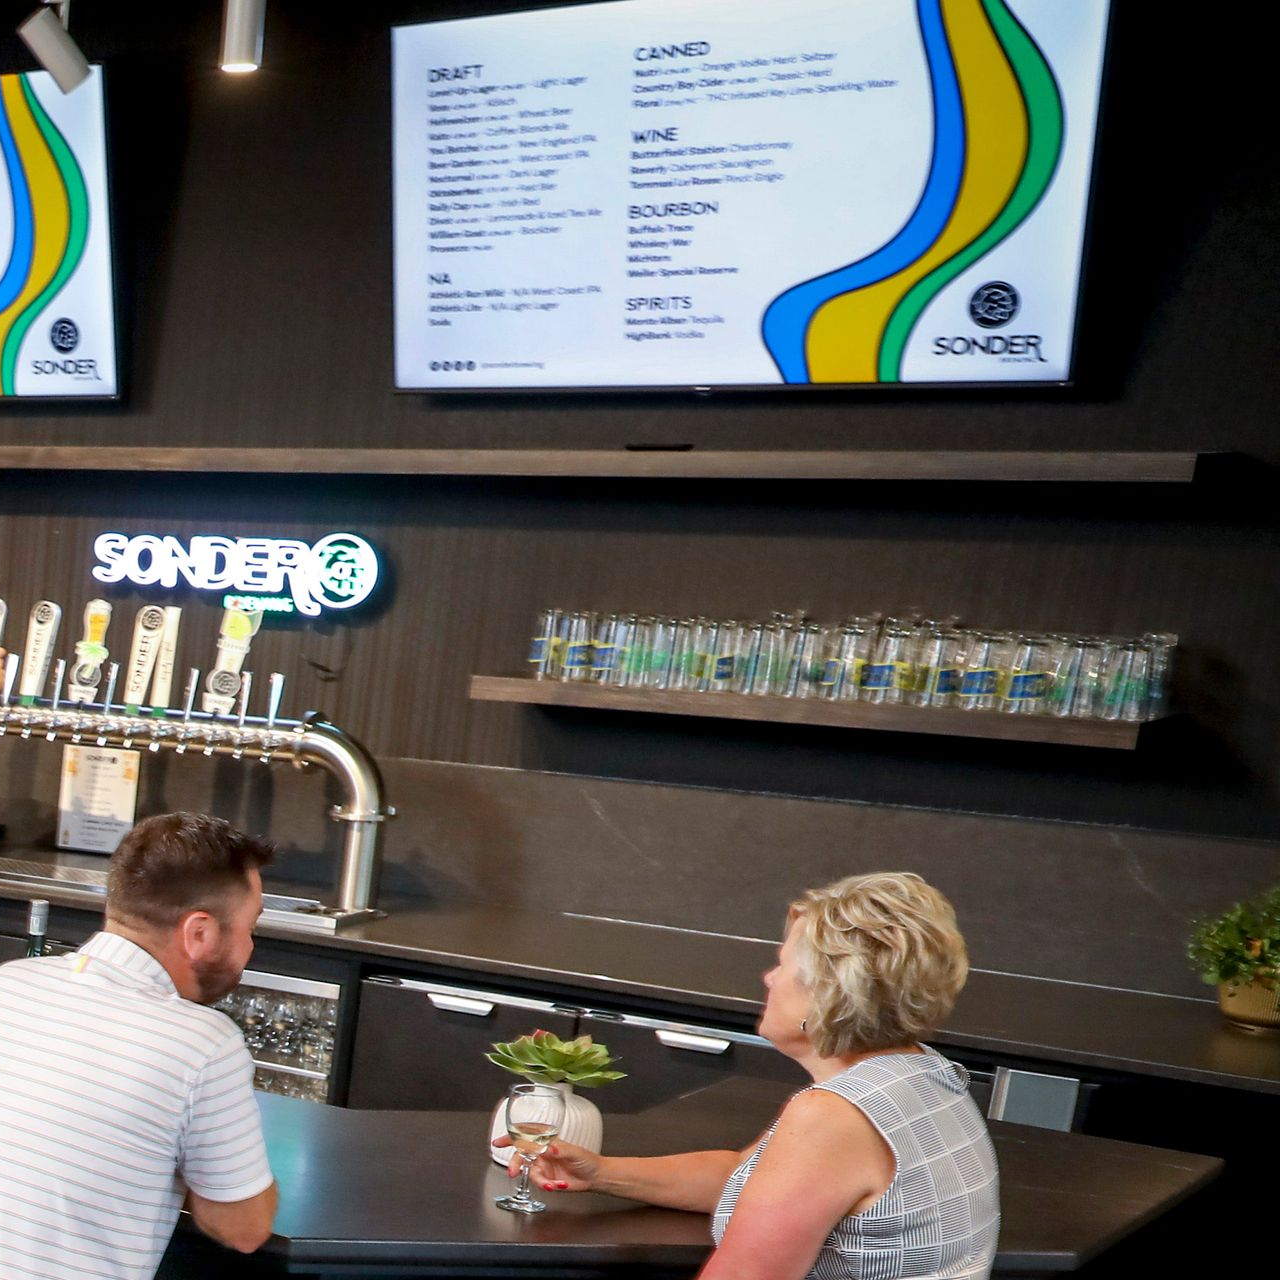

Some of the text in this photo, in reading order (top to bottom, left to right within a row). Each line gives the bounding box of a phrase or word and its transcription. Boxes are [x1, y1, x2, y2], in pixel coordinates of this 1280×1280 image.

[633, 41, 711, 61] CANNED
[428, 64, 484, 83] DRAFT
[631, 126, 680, 143] WINE
[628, 201, 719, 219] BOURBON
[428, 272, 453, 286] NA
[625, 295, 693, 311] SPIRITS
[932, 334, 1048, 363] SONDER
[31, 358, 103, 381] SONDER
[92, 532, 322, 616] SONDER
[130, 633, 152, 693] SONDER
